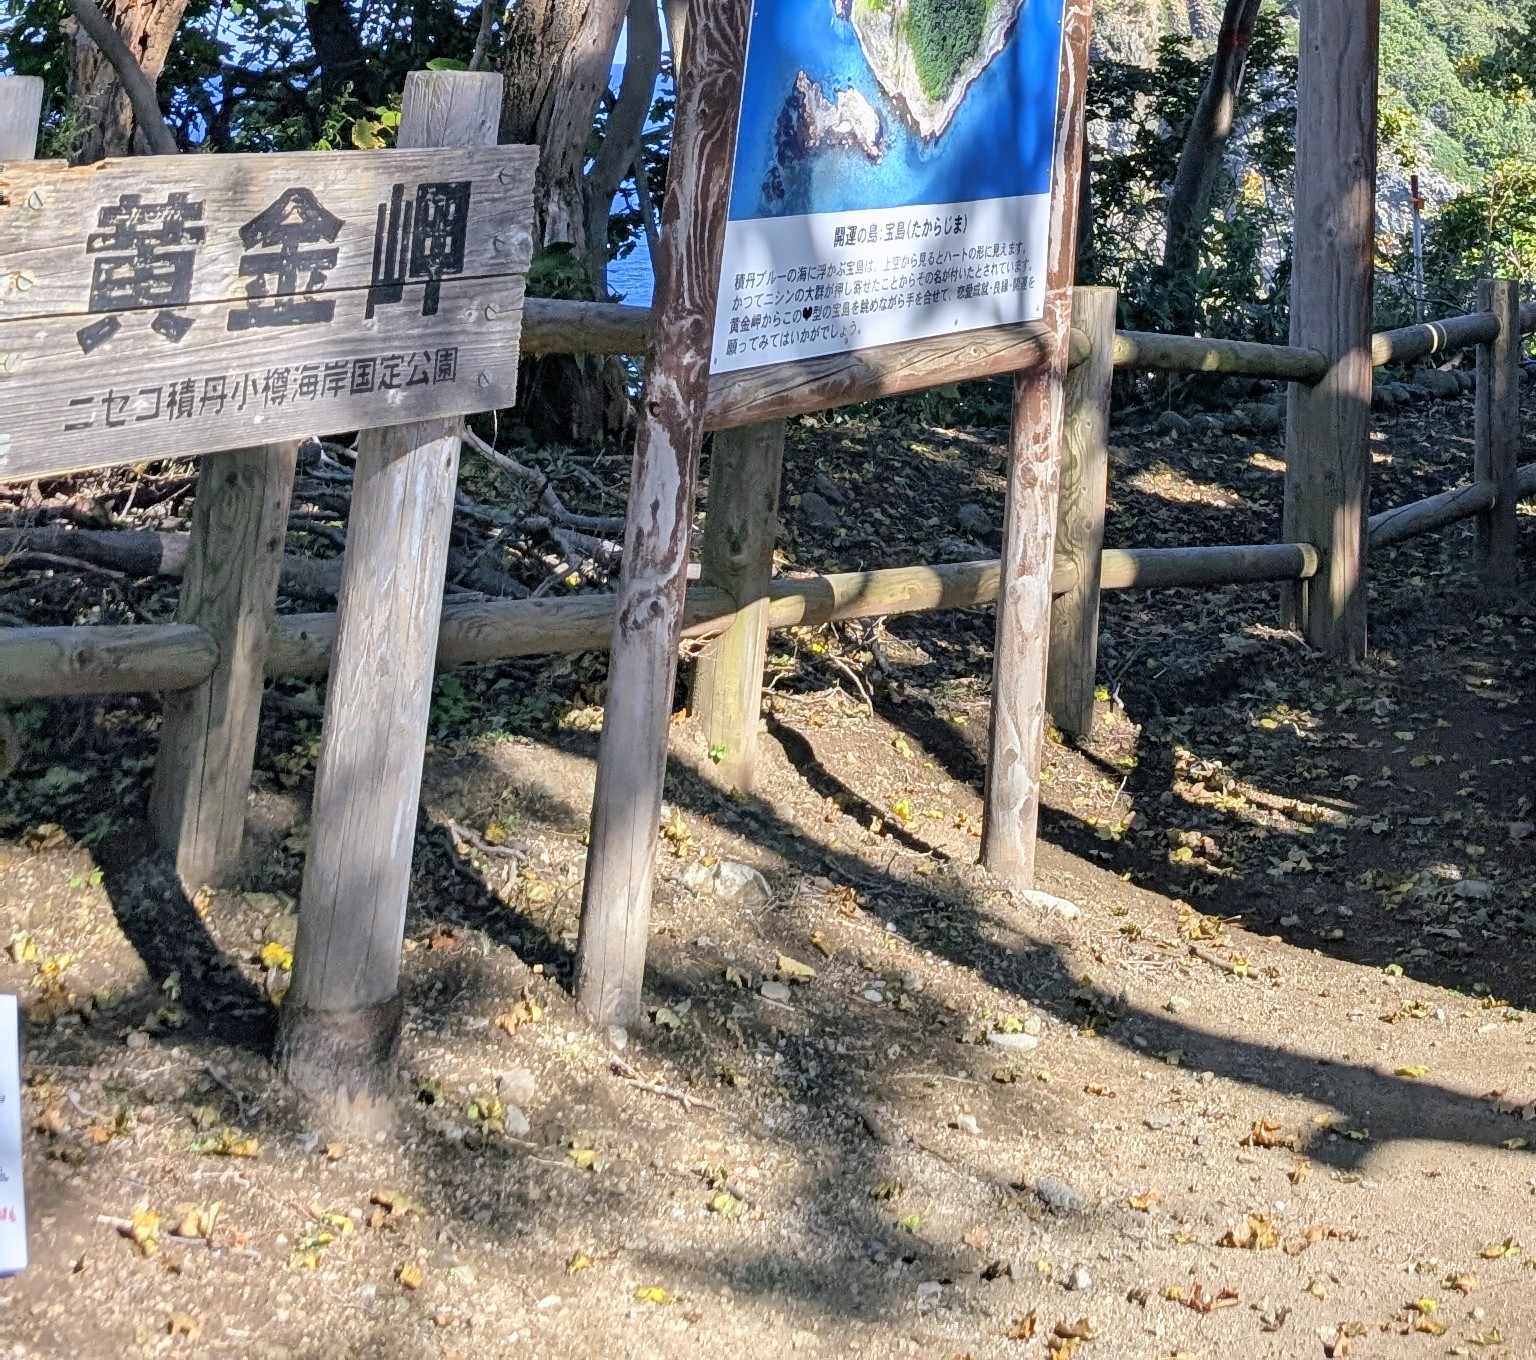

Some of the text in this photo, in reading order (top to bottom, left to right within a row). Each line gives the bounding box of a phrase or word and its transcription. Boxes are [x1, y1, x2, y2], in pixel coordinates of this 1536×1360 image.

[76, 180, 472, 353] 黄金岬
[63, 346, 459, 431] ニセコ積丹小樽海岸国定公園
